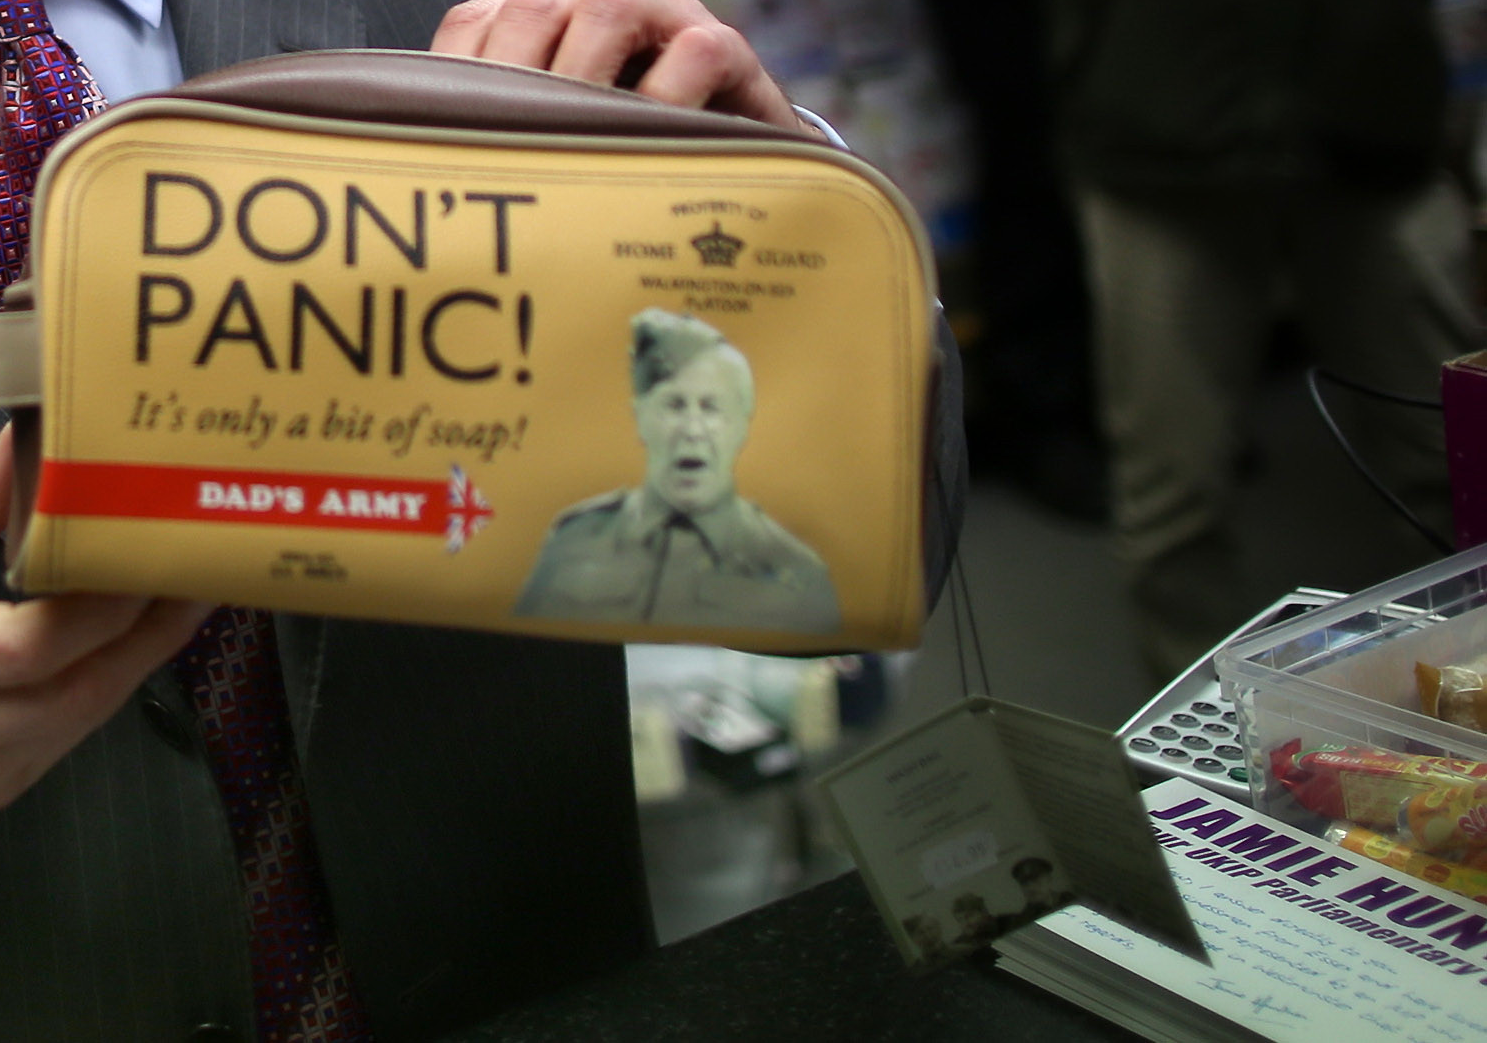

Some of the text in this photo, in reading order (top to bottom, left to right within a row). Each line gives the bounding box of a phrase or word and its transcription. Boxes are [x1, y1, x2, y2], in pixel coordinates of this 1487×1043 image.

[142, 171, 539, 275] DON'T
[614, 240, 827, 270] HOME GUARD
[135, 272, 534, 386] PANIC!
[127, 391, 530, 462] It's only a bit of soap!
[197, 481, 428, 522] DAD'S ARMY
[1149, 797, 1359, 887] JAMIE
[1336, 876, 1487, 960] HUN
[1150, 822, 1193, 849] our
[1184, 847, 1265, 878] UKIP
[1250, 877, 1486, 975] Parliamentary
[1230, 935, 1327, 977] represented
[1255, 930, 1300, 948] from
[1303, 950, 1353, 972] Essex
[1269, 917, 1335, 947] directly
